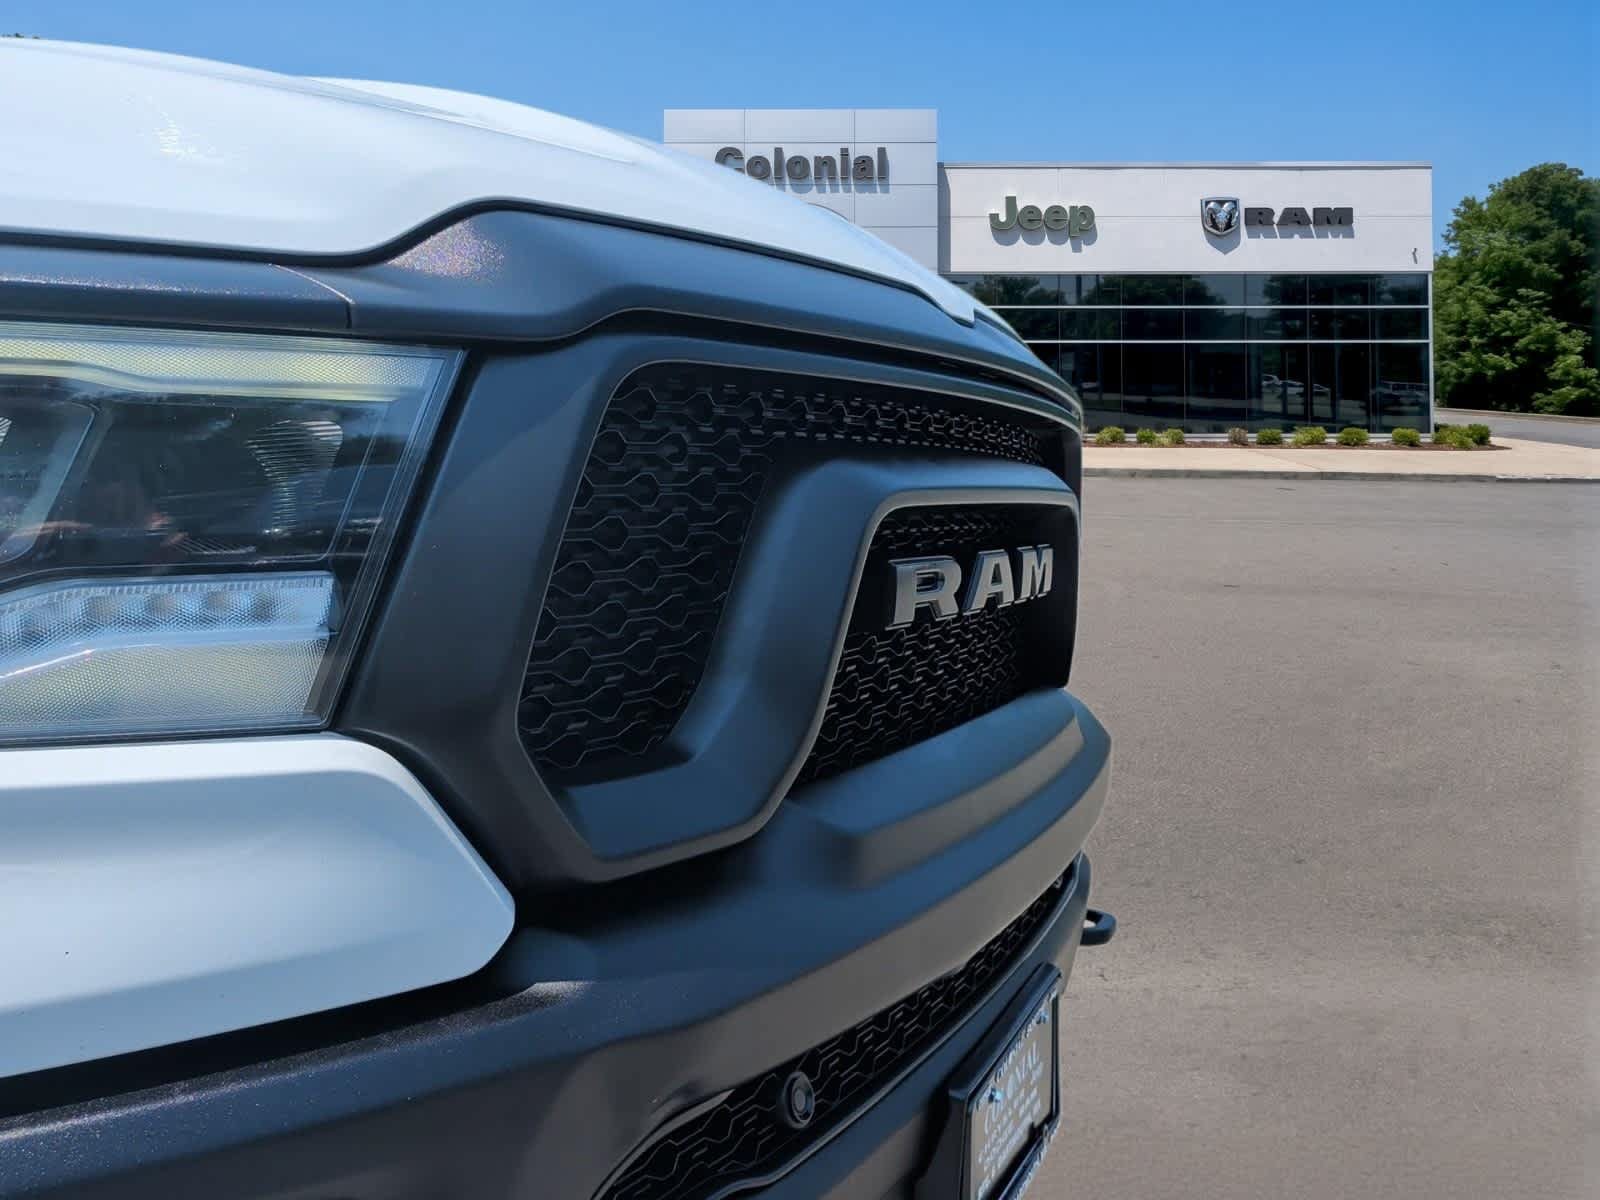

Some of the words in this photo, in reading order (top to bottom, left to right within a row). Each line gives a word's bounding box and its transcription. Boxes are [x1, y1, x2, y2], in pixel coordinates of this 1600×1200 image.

[715, 147, 889, 180] Colonial
[989, 196, 1095, 237] Jeep
[1244, 207, 1354, 226] RAM
[886, 544, 1054, 630] RAM
